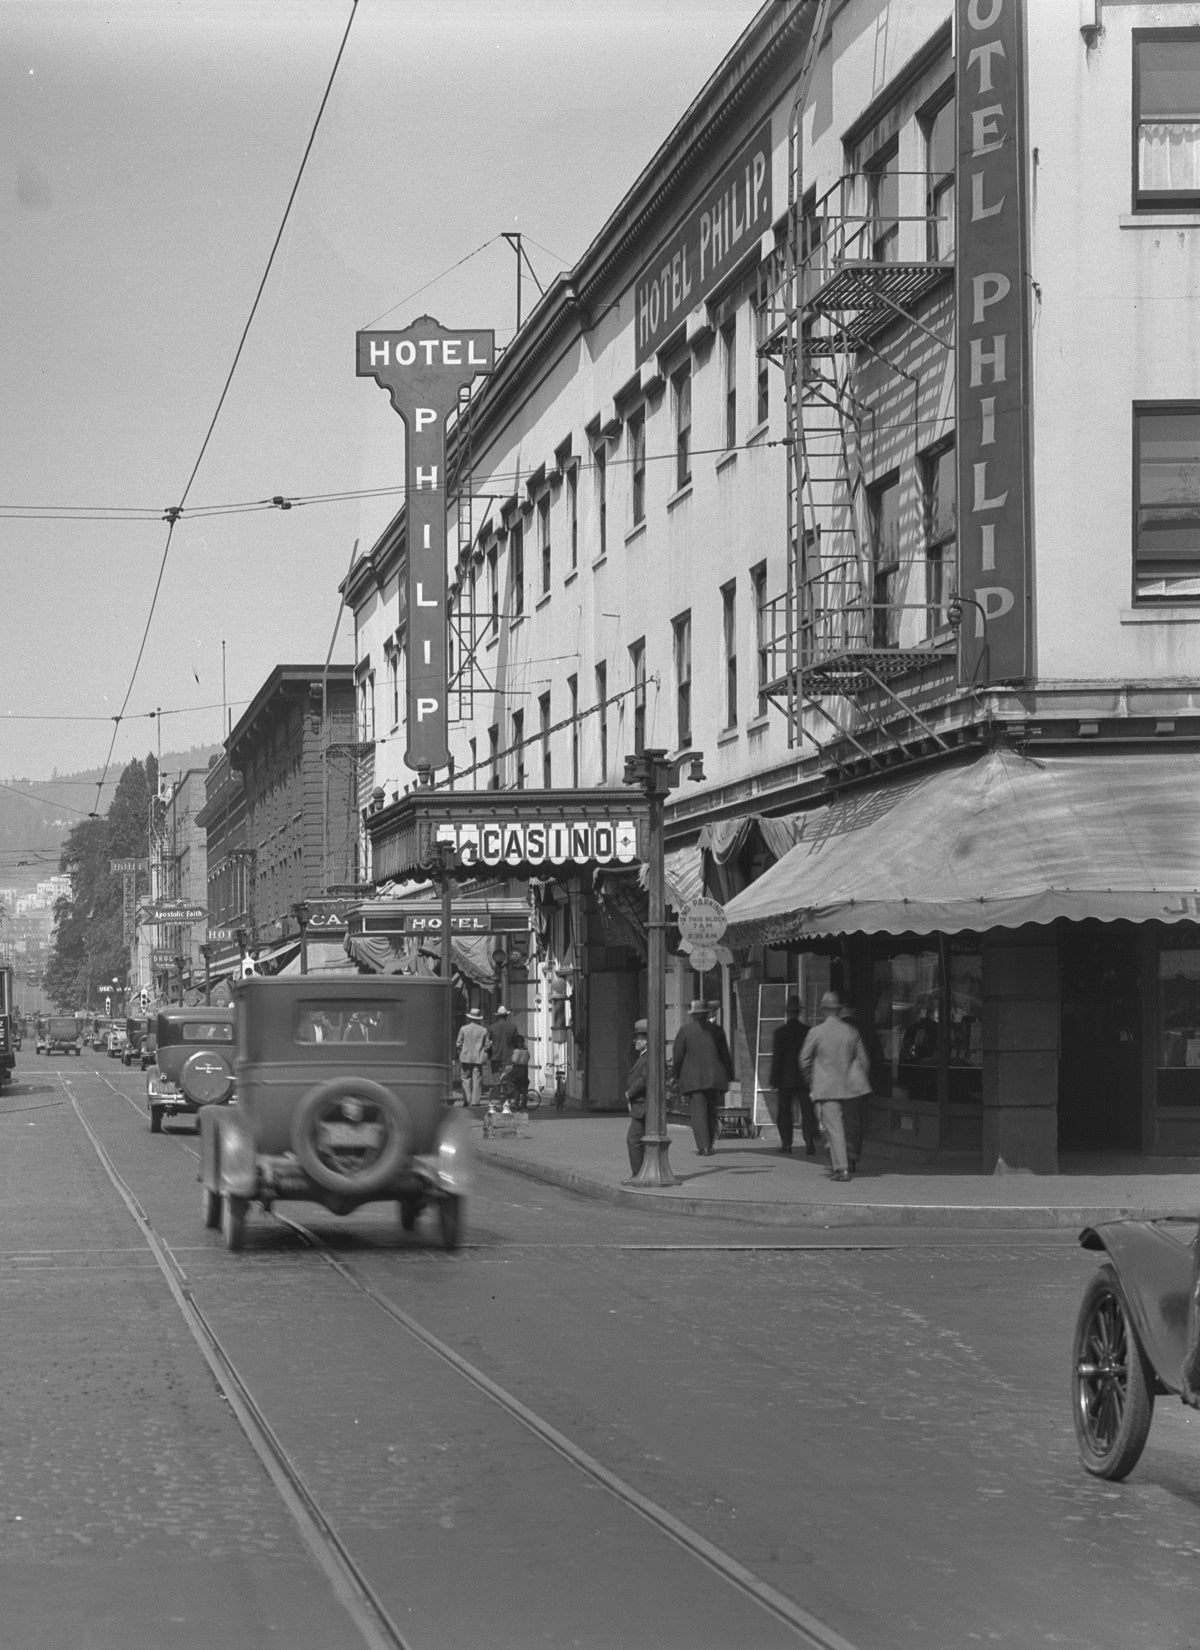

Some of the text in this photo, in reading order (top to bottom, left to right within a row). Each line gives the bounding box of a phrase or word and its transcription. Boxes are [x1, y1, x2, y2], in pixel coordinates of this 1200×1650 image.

[639, 242, 692, 349] HOTEL
[369, 340, 487, 366] HOTEL
[970, 271, 1015, 640] PHILIP
[414, 408, 440, 722] PHILIP
[483, 828, 612, 859] CASINO
[154, 910, 203, 919] Apostolic Faith
[681, 898, 725, 916] NO PARKING
[309, 914, 349, 926] CA
[412, 917, 488, 929] HOTEL
[208, 929, 233, 939] HOT
